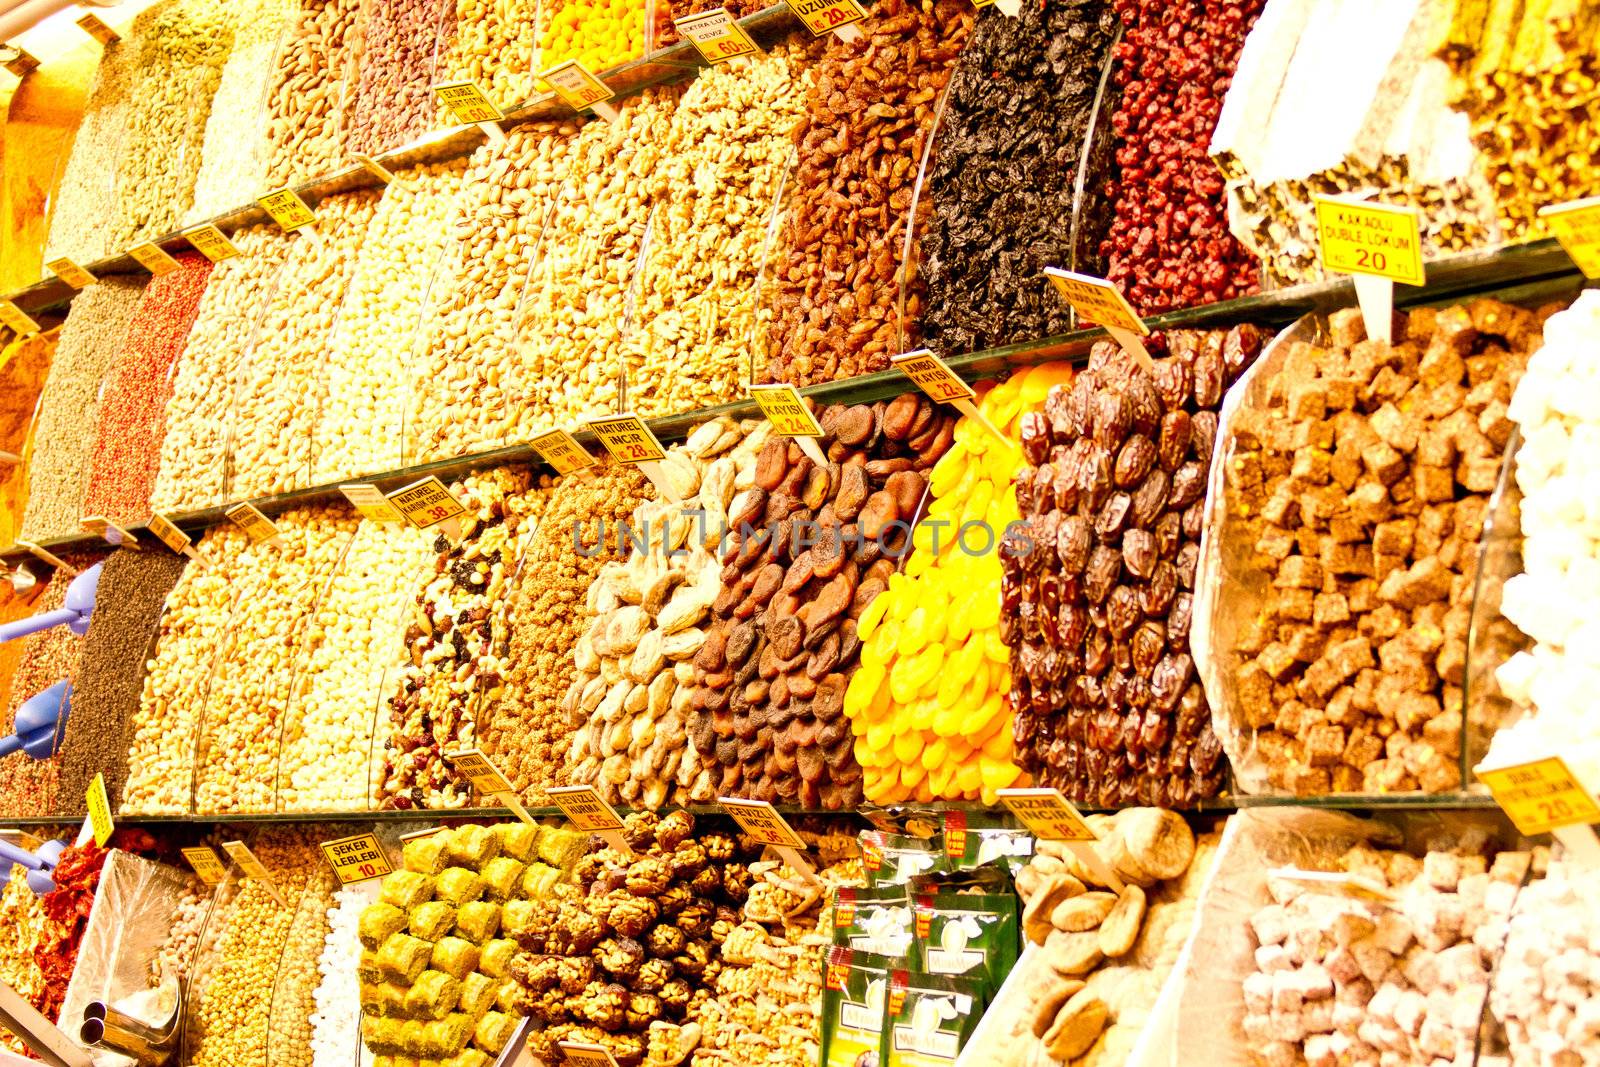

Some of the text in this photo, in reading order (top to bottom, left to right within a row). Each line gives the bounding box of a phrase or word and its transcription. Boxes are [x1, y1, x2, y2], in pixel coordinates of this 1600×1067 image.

[711, 17, 728, 25] LUX
[822, 8, 846, 25] 20
[844, 9, 858, 17] TL
[718, 40, 741, 54] 60
[738, 43, 751, 51] TL
[580, 88, 598, 102] 60
[469, 108, 488, 120] 60
[1355, 248, 1387, 271] 20
[936, 383, 960, 397] 22
[761, 404, 803, 415] KAYISI
[594, 421, 641, 435] NATUREL
[785, 417, 806, 433] 24
[626, 444, 648, 459] 28
[397, 485, 436, 504] NATUREL
[427, 506, 449, 520] 38
[566, 803, 603, 815] HURMA
[1537, 798, 1573, 821] 20
[587, 814, 609, 827] 55
[332, 840, 369, 857] ŞEKER
[334, 850, 381, 867] LEBLEBİ
[357, 863, 377, 878] 10
[377, 865, 389, 873] TL
